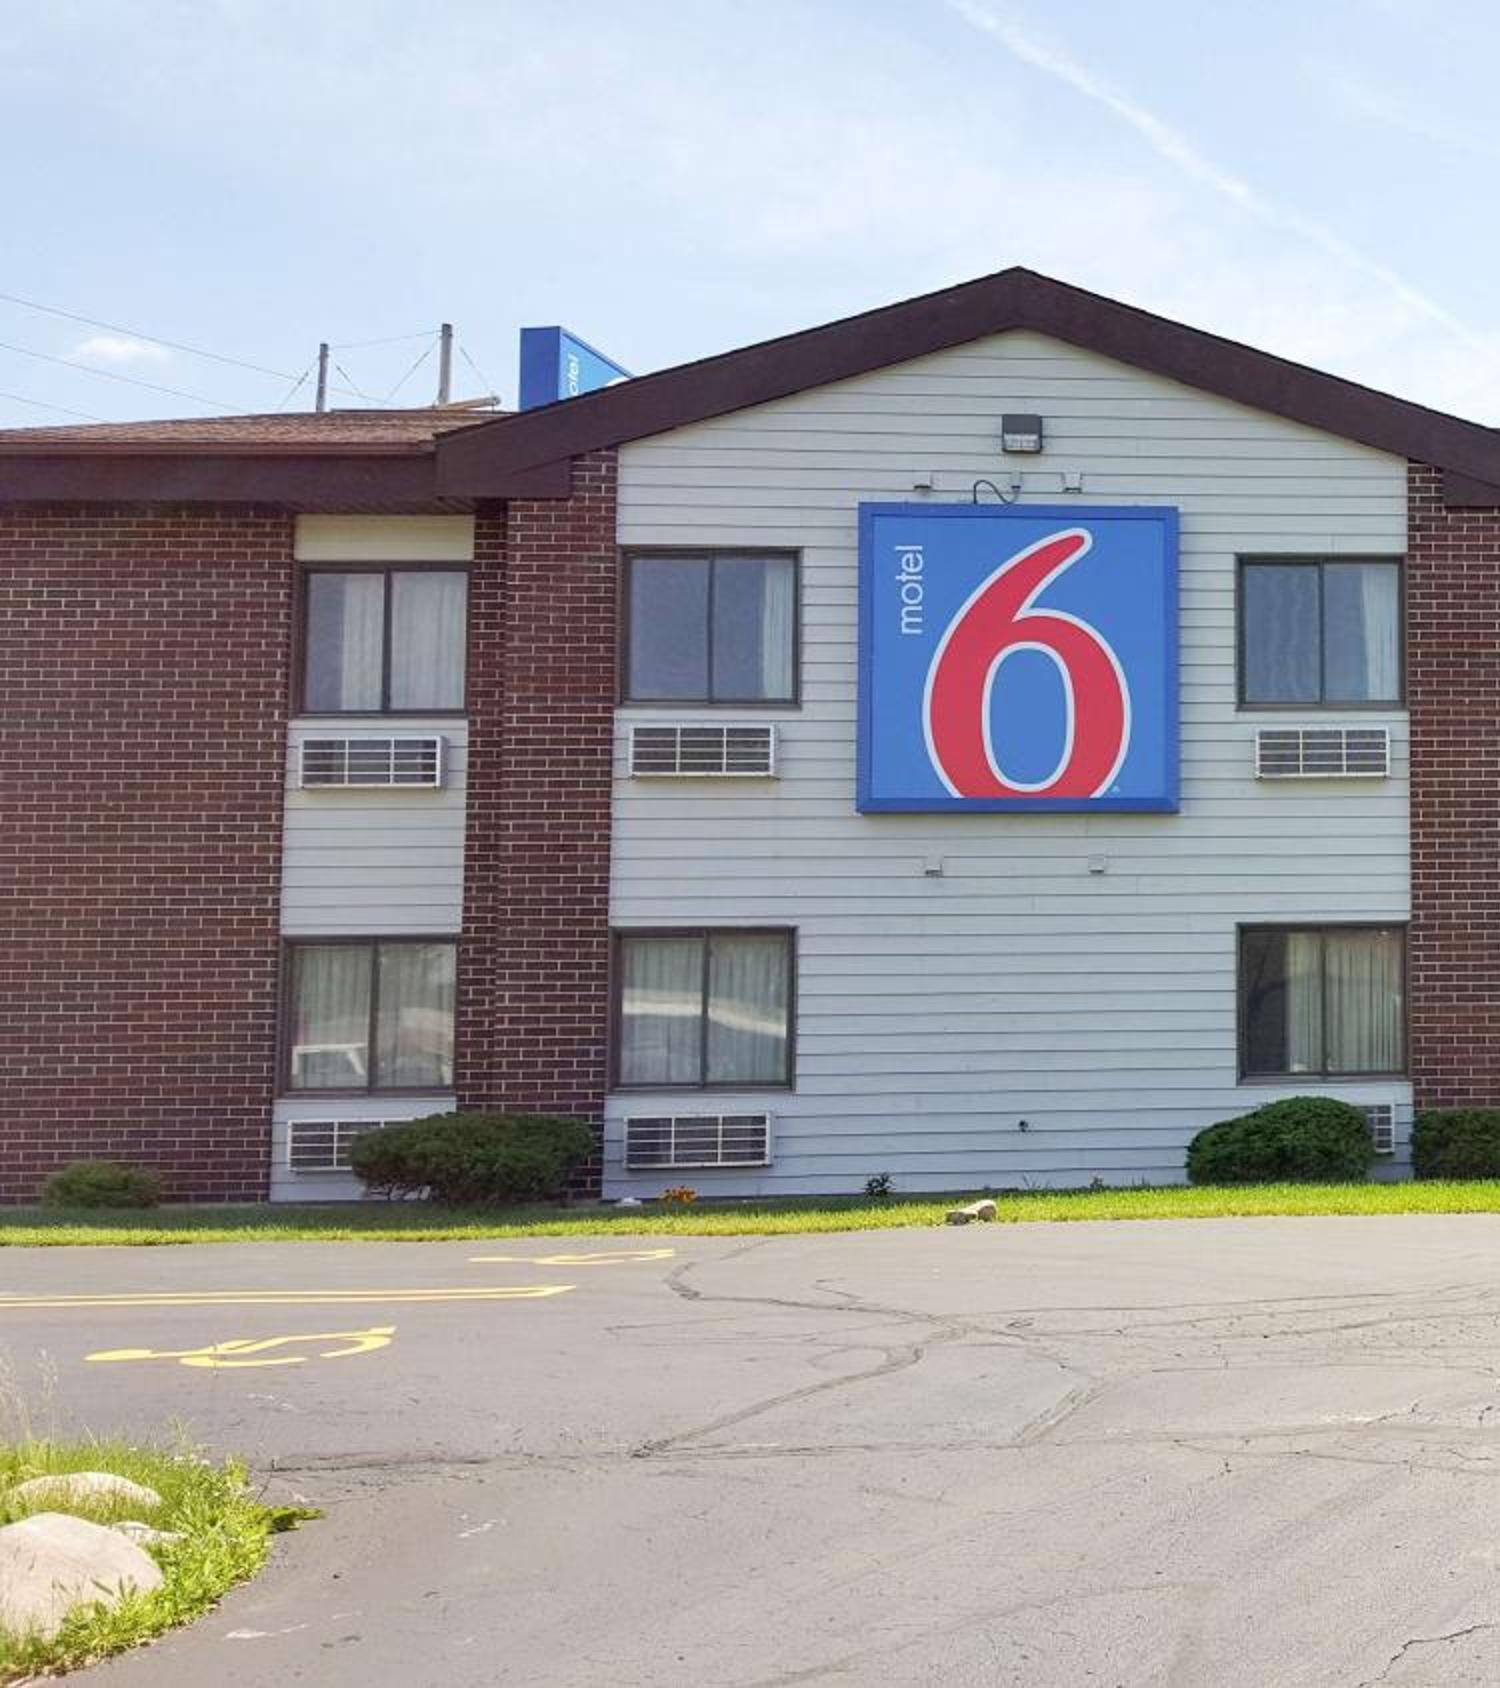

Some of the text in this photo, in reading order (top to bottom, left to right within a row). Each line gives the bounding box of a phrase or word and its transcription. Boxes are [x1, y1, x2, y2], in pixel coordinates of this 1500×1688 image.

[567, 351, 579, 396] otel
[895, 528, 1131, 798] motel 6
